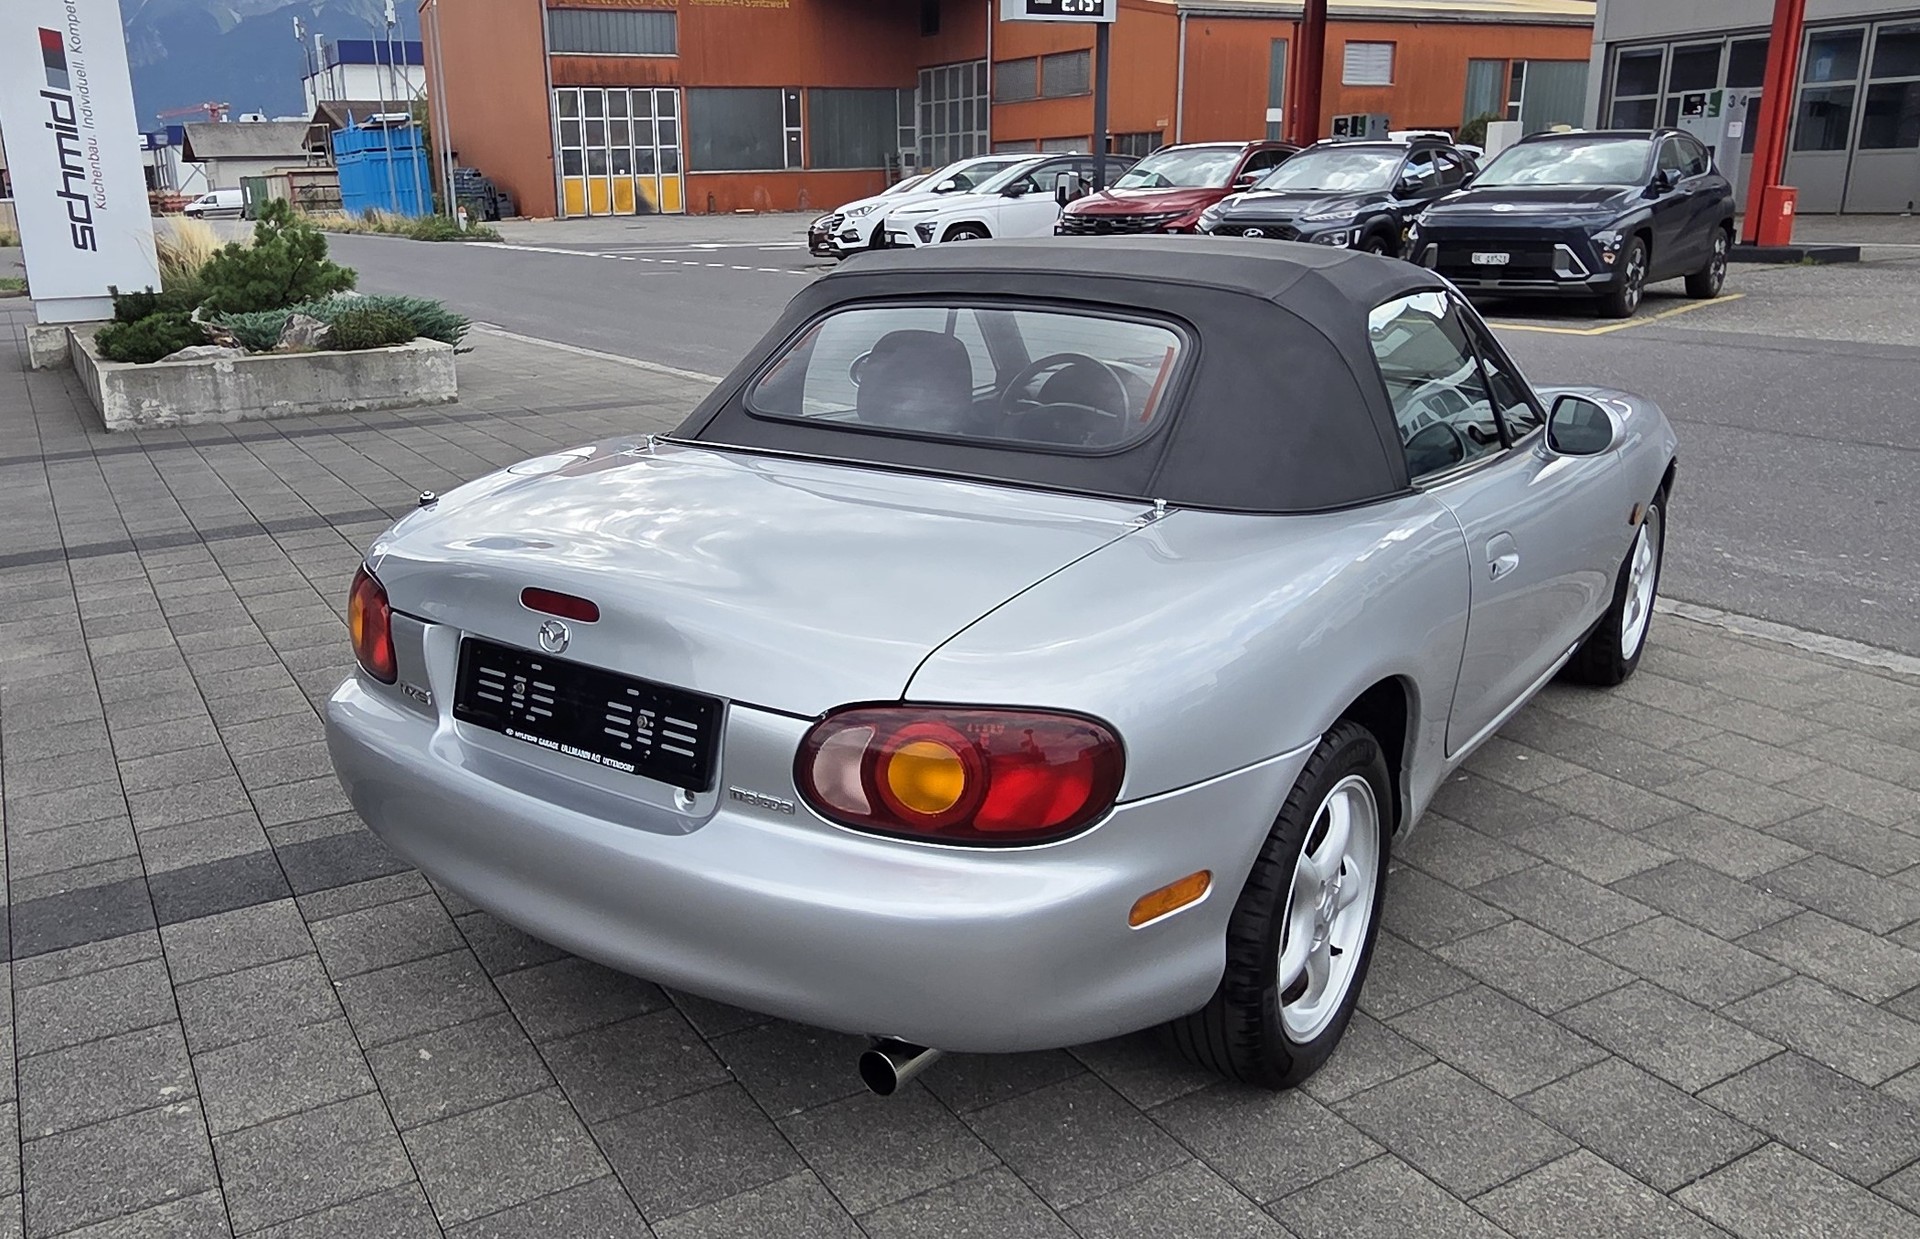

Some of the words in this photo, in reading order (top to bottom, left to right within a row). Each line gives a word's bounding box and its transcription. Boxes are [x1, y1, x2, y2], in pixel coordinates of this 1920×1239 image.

[72, 60, 94, 130] Individuell.
[1728, 95, 1735, 108] 3
[1740, 95, 1747, 108] 4
[40, 90, 97, 252] schmid
[89, 134, 107, 210] Küchenbau.
